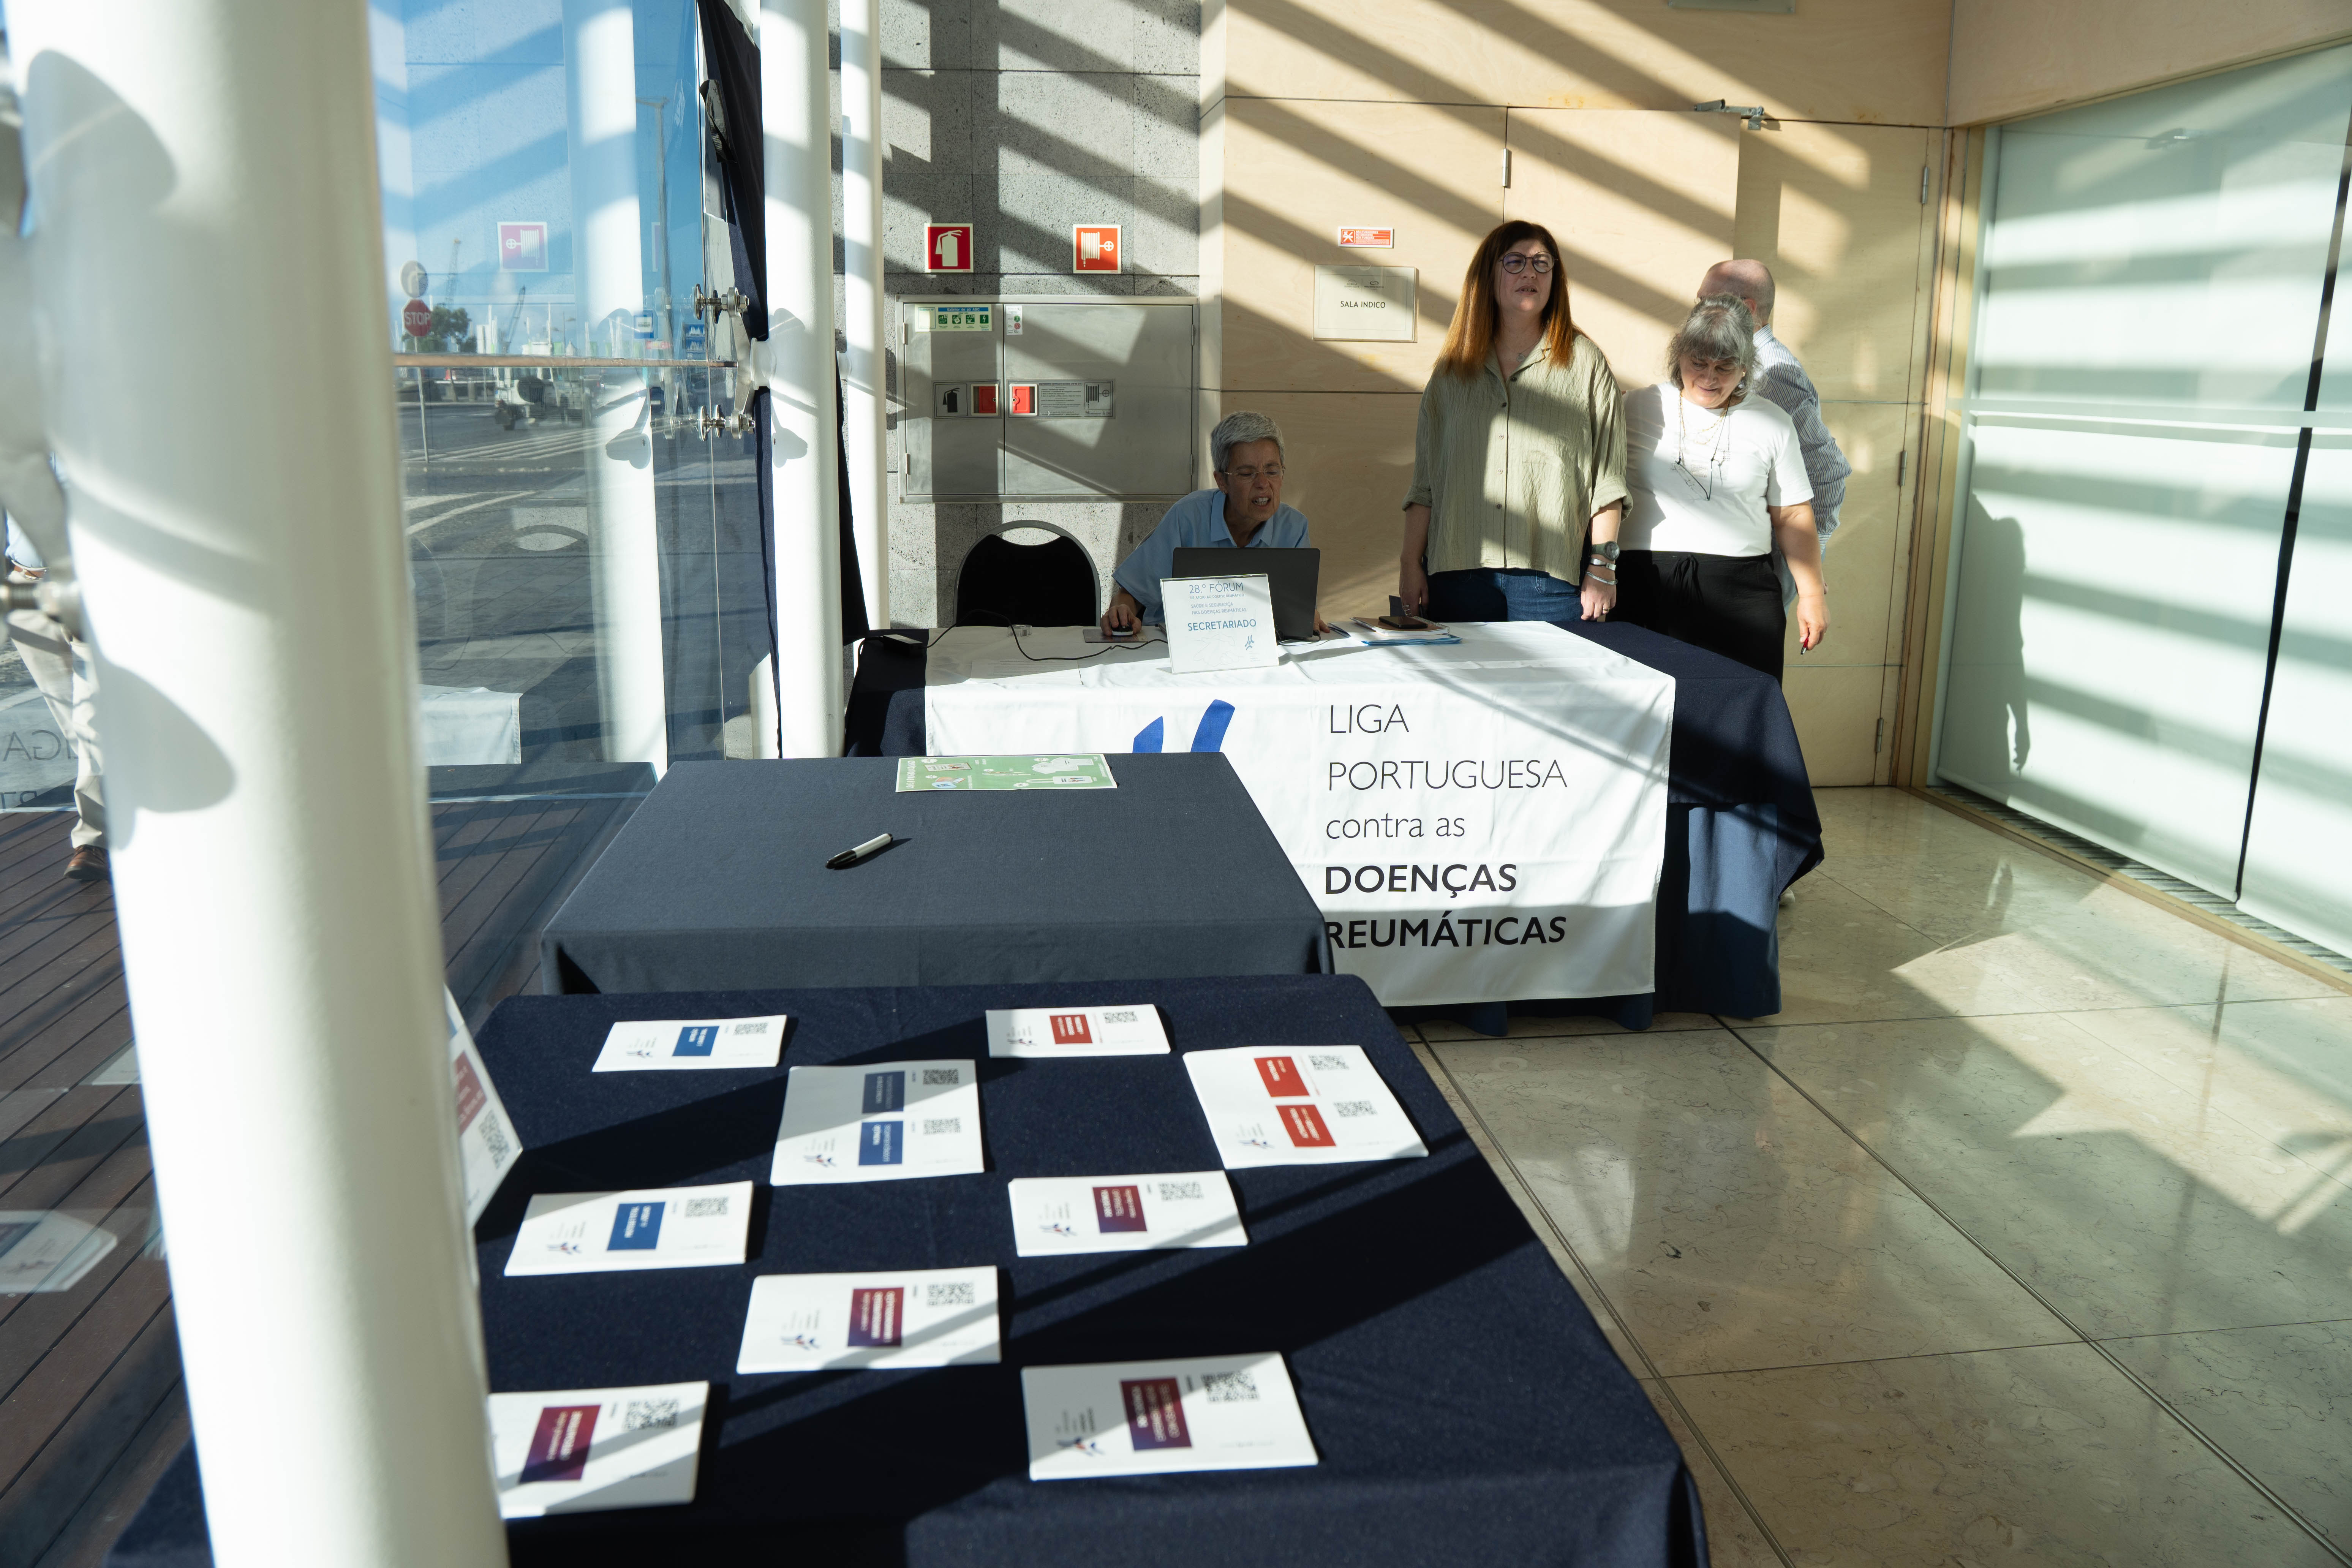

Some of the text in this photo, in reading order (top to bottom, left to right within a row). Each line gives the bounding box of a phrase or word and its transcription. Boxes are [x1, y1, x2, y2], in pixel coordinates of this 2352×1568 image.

[405, 312, 430, 326] STOP
[1209, 581, 1244, 593] FÓRUM
[1188, 619, 1257, 631] SECRETARIADO
[1330, 704, 1409, 733] LIGA
[1329, 759, 1568, 791] PORTUGUESA
[1326, 812, 1465, 839] contra as
[1325, 864, 1517, 898] DOENÇAS
[1326, 910, 1566, 948] REUMÁTICAS
